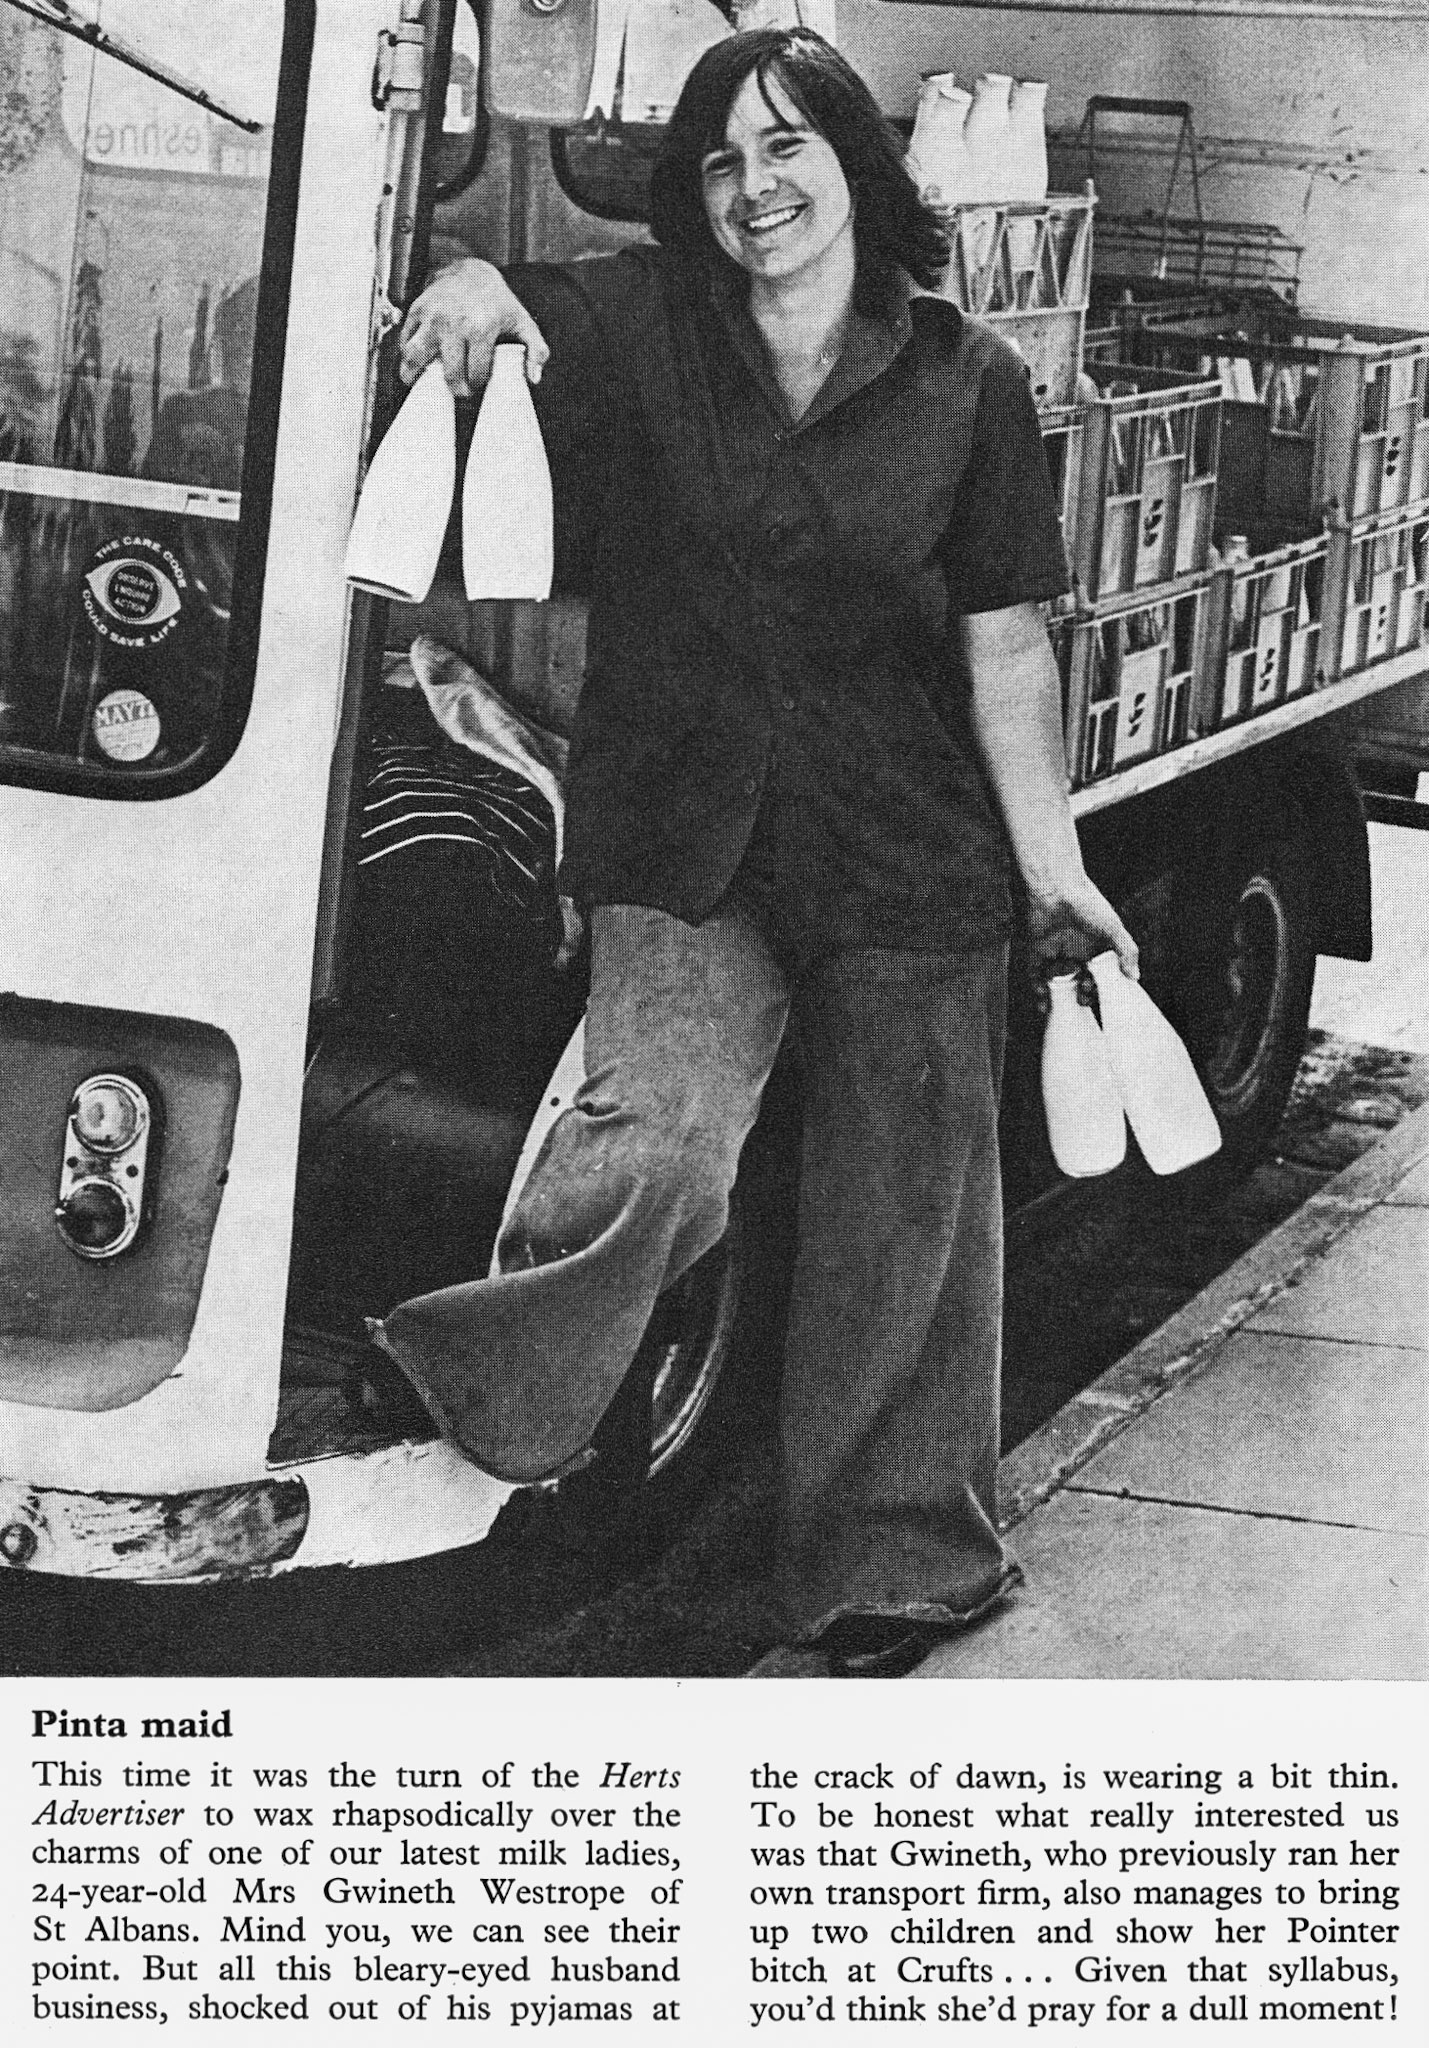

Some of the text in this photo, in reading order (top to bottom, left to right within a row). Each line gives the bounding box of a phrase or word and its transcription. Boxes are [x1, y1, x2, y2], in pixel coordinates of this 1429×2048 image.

[95, 536, 187, 589] THE CARE CODE
[82, 588, 178, 647] COULD SAVE LIFE
